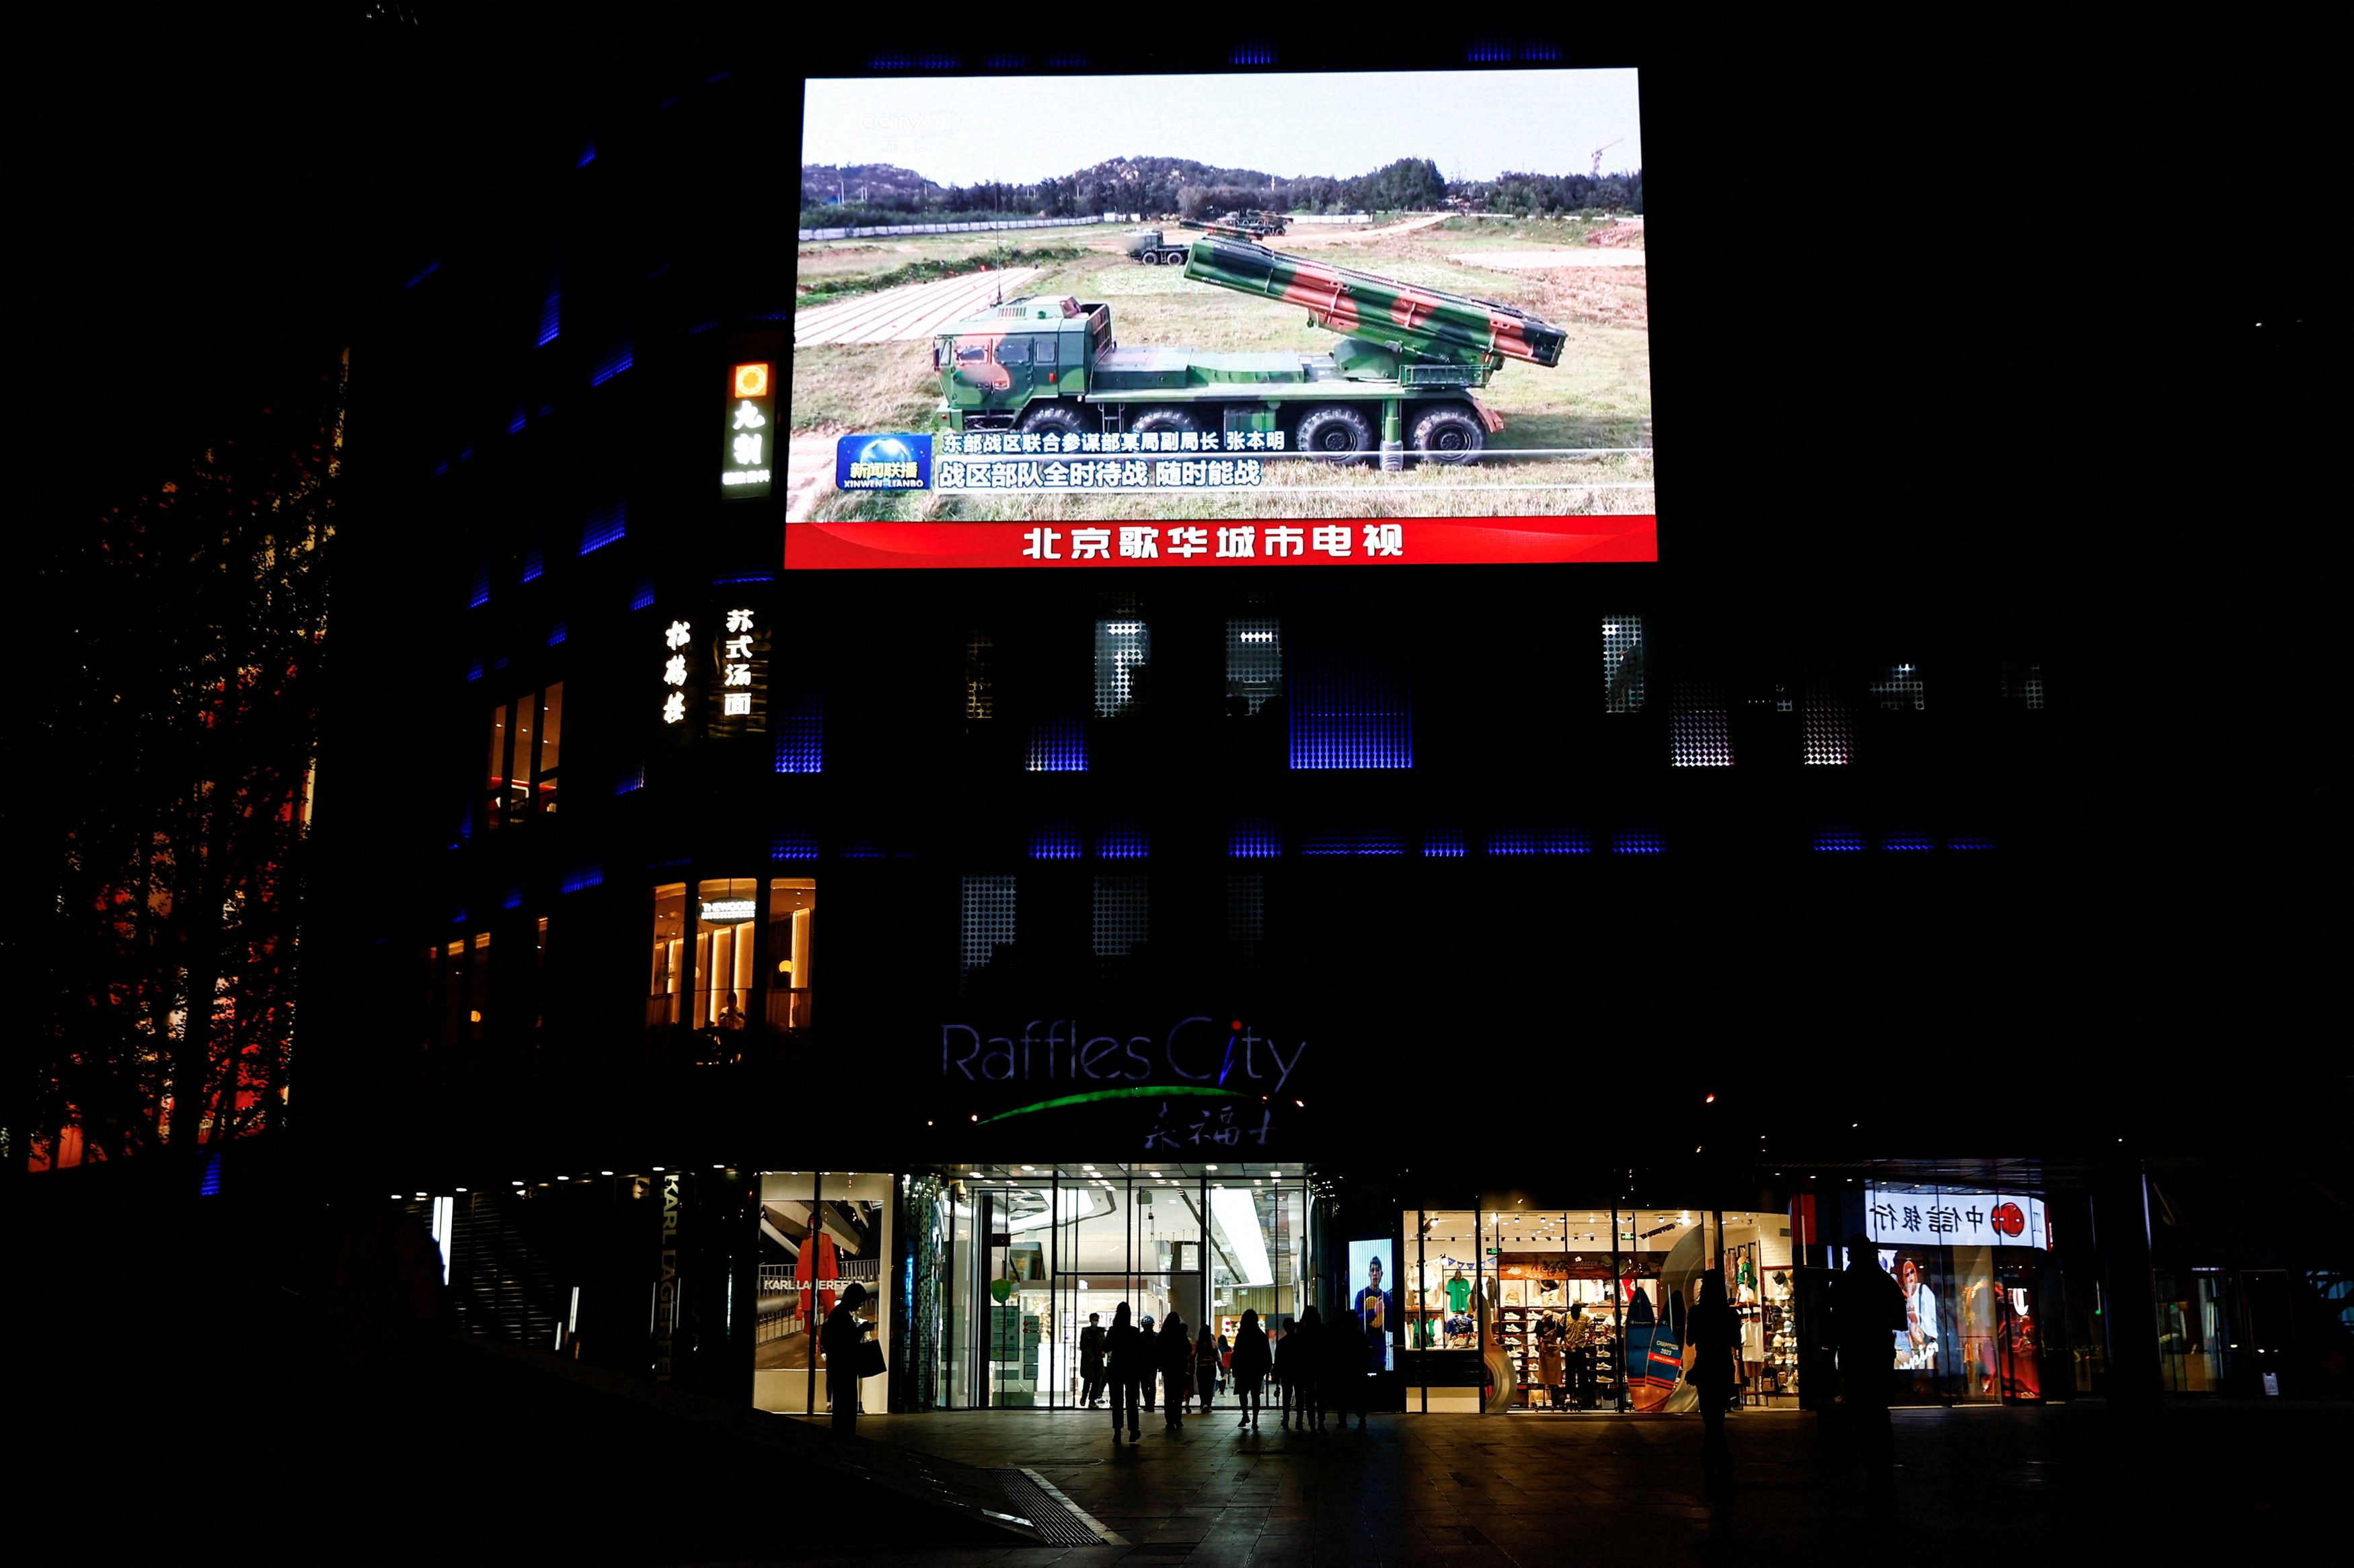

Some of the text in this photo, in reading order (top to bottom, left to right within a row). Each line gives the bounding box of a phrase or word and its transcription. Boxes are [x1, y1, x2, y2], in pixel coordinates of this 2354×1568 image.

[943, 431, 1285, 453] 东部战区联合参谋部某局副局长 张本明
[844, 479, 923, 488] XINWEN LIANBO
[849, 462, 918, 479] 新闻联播
[938, 459, 1261, 488] 战区部队全时待战 随时能战
[1022, 524, 1404, 559] 北京歌华城市电视
[724, 609, 754, 716] 苏式汤面
[942, 1016, 1306, 1093] Raffles City
[656, 1175, 679, 1383] KARL LAGERFEL
[764, 1280, 795, 1290] KARL
